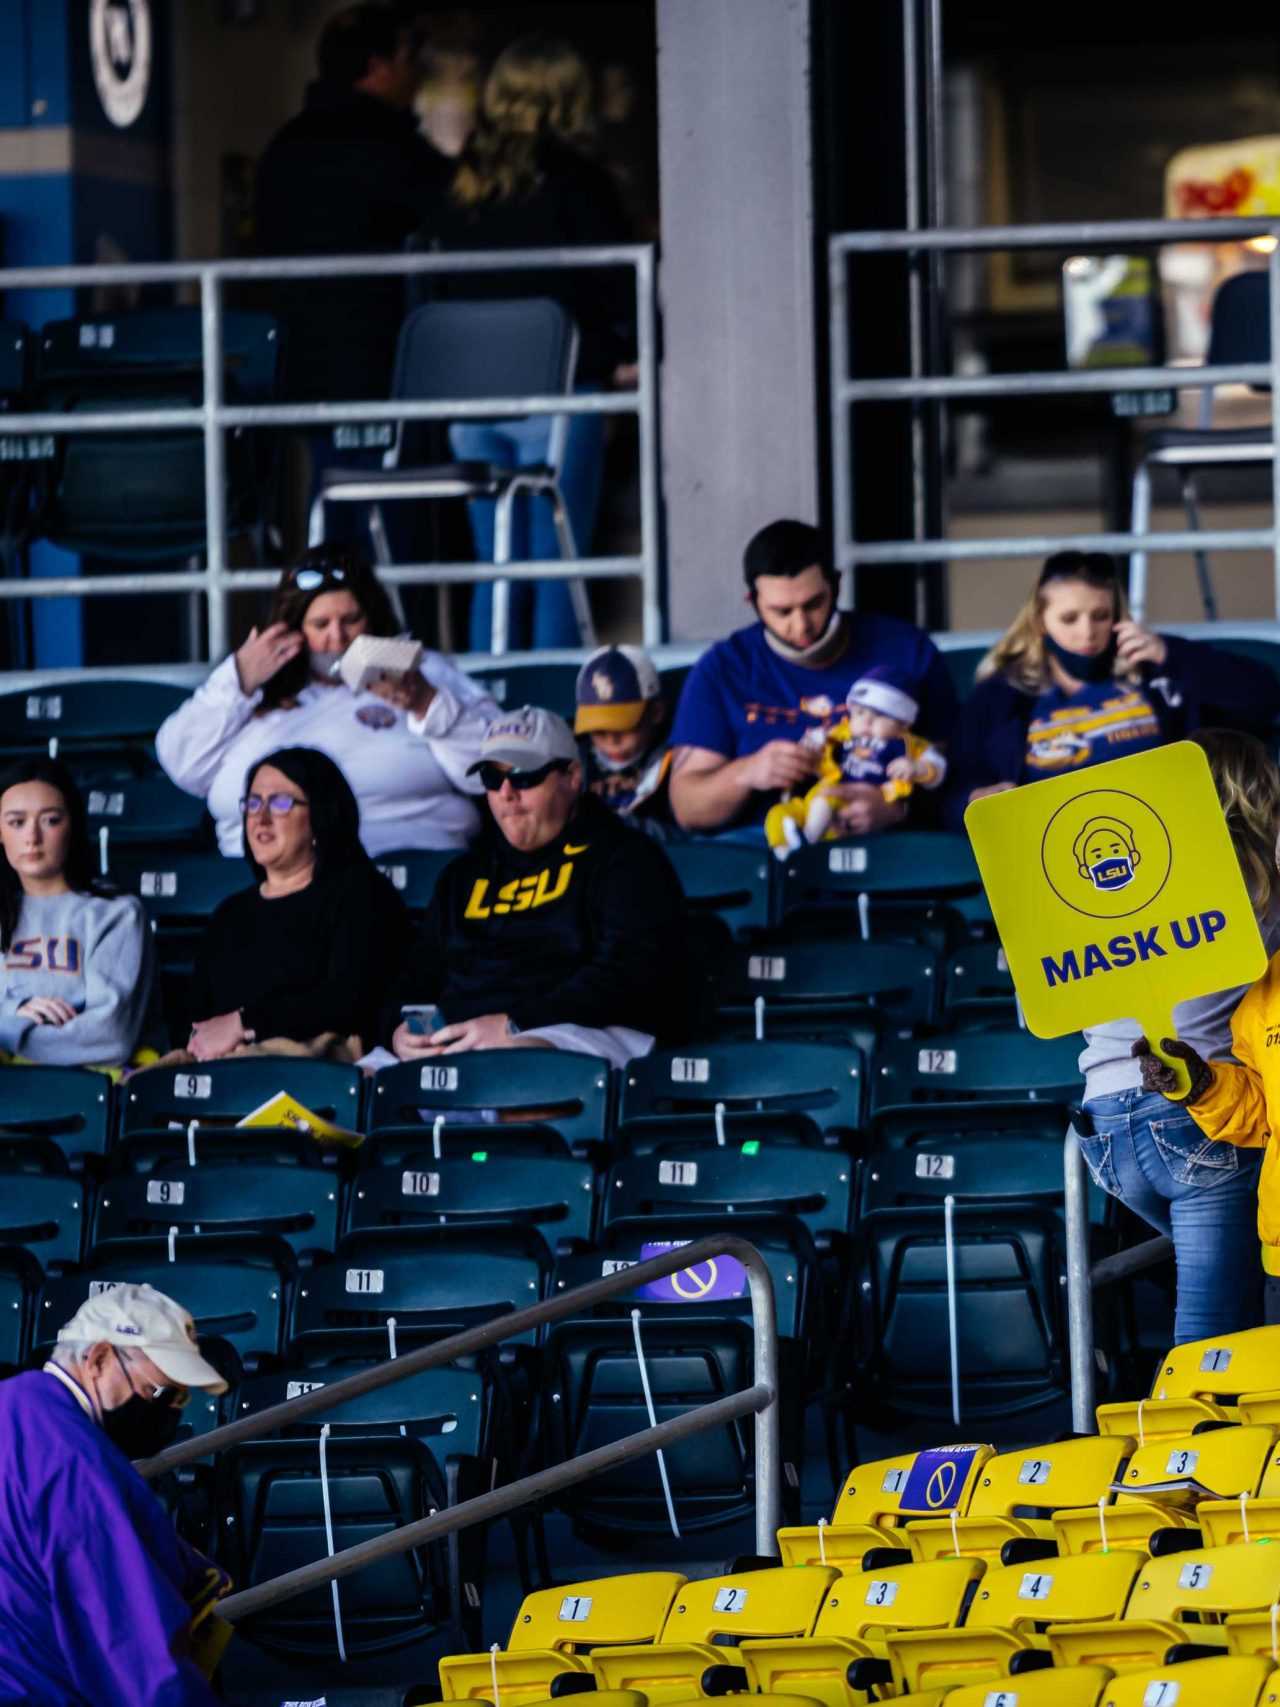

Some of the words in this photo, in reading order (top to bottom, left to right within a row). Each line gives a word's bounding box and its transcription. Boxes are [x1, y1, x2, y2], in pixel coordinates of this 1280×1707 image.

[1097, 865, 1127, 882] LSU
[464, 862, 574, 919] LSU
[5, 937, 80, 973] SU
[1040, 926, 1168, 987] MASK
[1169, 910, 1226, 949] UP
[760, 958, 773, 978] 11
[685, 1060, 697, 1081] 11
[928, 1051, 946, 1073] 12
[187, 1075, 198, 1097] 9
[428, 1067, 450, 1090] 10
[671, 1163, 685, 1184] 11
[925, 1155, 944, 1177] 12
[160, 1182, 171, 1203] 9
[411, 1173, 431, 1194] 10
[356, 1272, 372, 1292] 11
[1213, 1350, 1221, 1370] 1
[1029, 1462, 1041, 1482] 2
[1177, 1452, 1188, 1473] 3
[894, 1471, 902, 1491] 1
[1031, 1576, 1041, 1597] 4
[1190, 1565, 1202, 1587] 5
[724, 1590, 736, 1611] 2
[876, 1583, 887, 1604] 3
[572, 1599, 580, 1619] 1
[1156, 1683, 1168, 1706] 7
